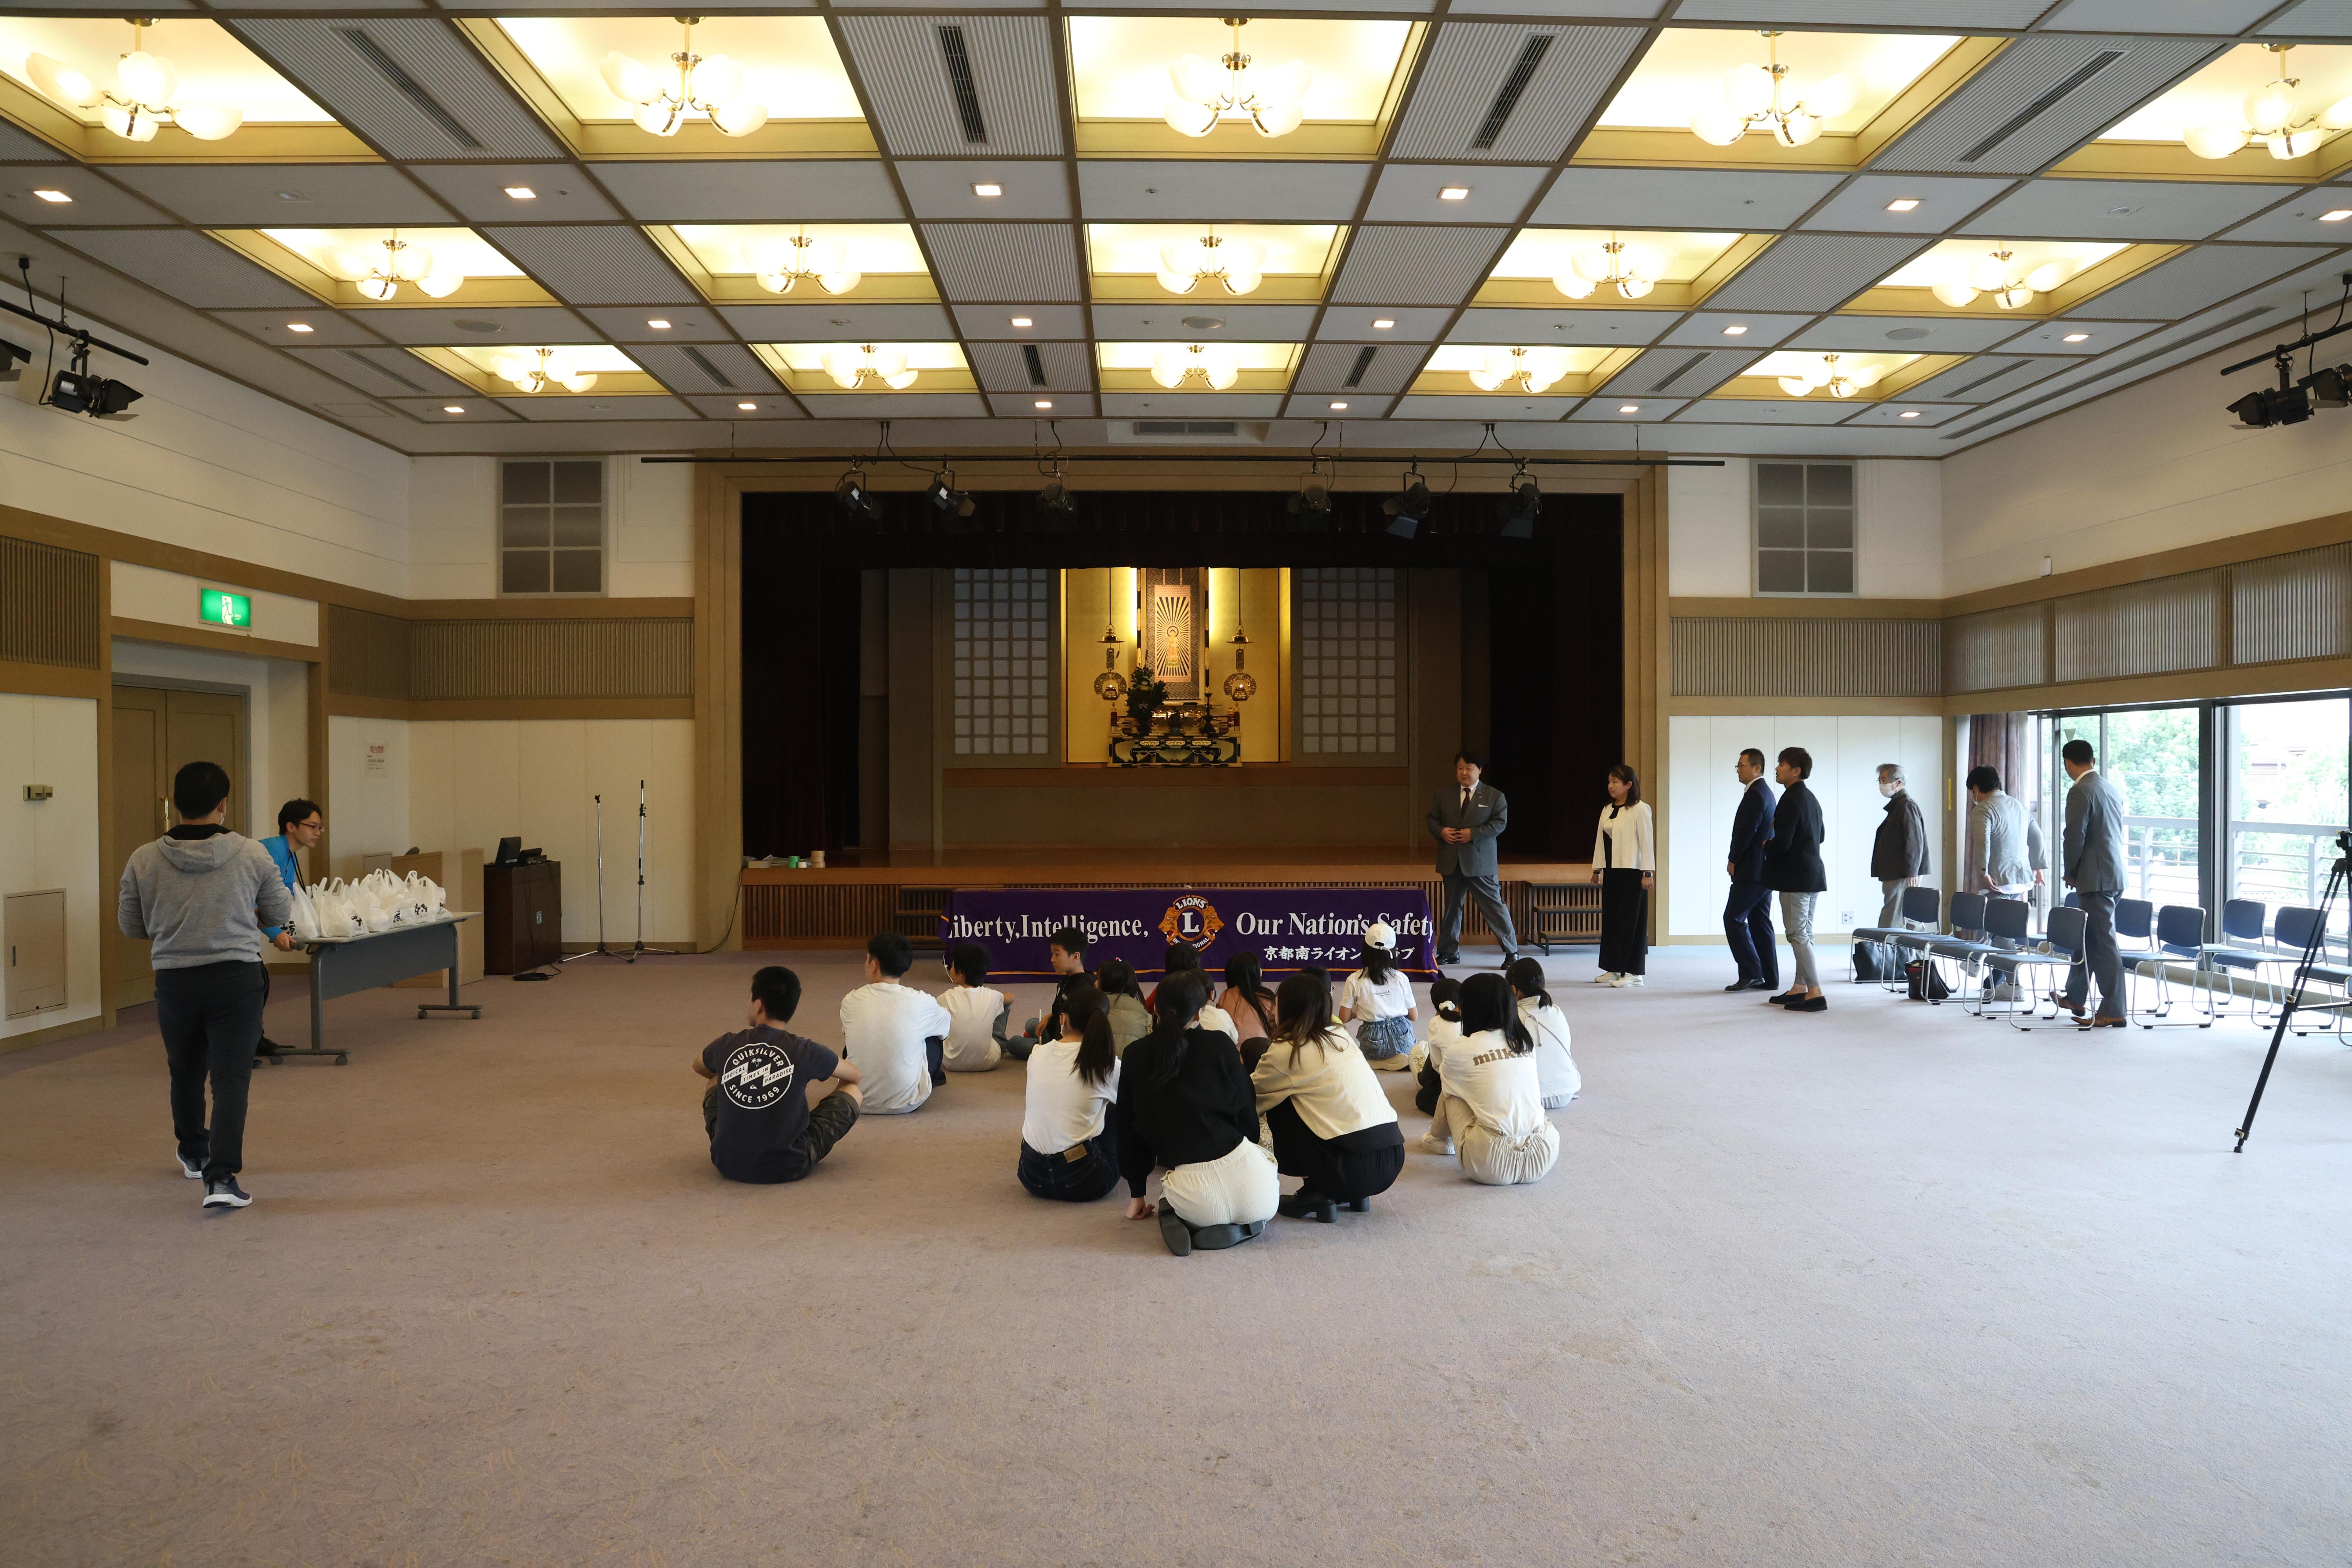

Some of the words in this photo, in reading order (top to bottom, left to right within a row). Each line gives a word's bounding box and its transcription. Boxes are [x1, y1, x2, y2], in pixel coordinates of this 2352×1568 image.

[1176, 898, 1206, 909] LIONS
[1182, 912, 1200, 933] L
[1236, 912, 1283, 935] Our
[1287, 912, 1370, 935] Nation's
[732, 1047, 784, 1067] QUIKSILVER
[723, 1065, 746, 1080] RADICAL
[743, 1071, 760, 1082] TIMES
[764, 1067, 792, 1083] PARADISE
[729, 1084, 753, 1103] SINCE
[757, 1087, 780, 1103] 1969
